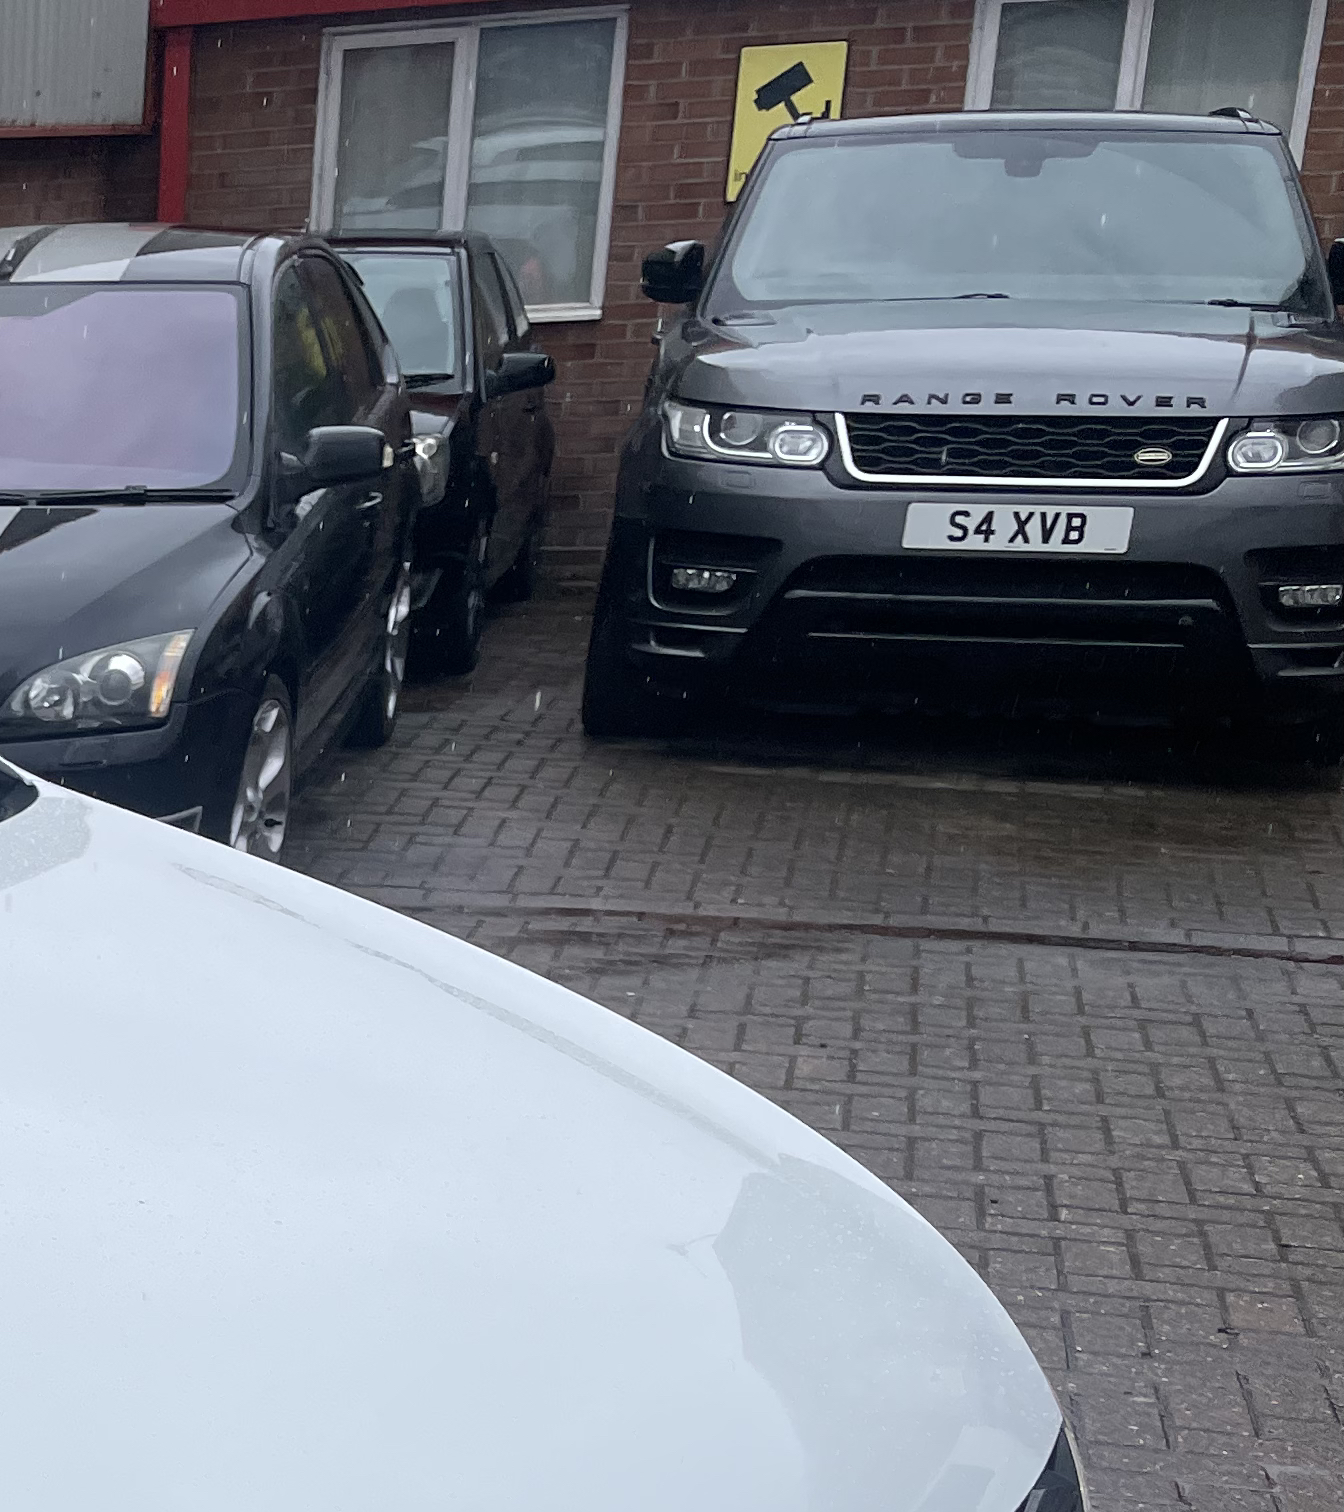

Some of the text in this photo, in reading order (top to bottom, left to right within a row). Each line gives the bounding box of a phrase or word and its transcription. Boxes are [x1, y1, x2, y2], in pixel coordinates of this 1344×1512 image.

[860, 391, 1208, 409] RANGE ROVER
[947, 509, 1088, 546] S4 XVB
